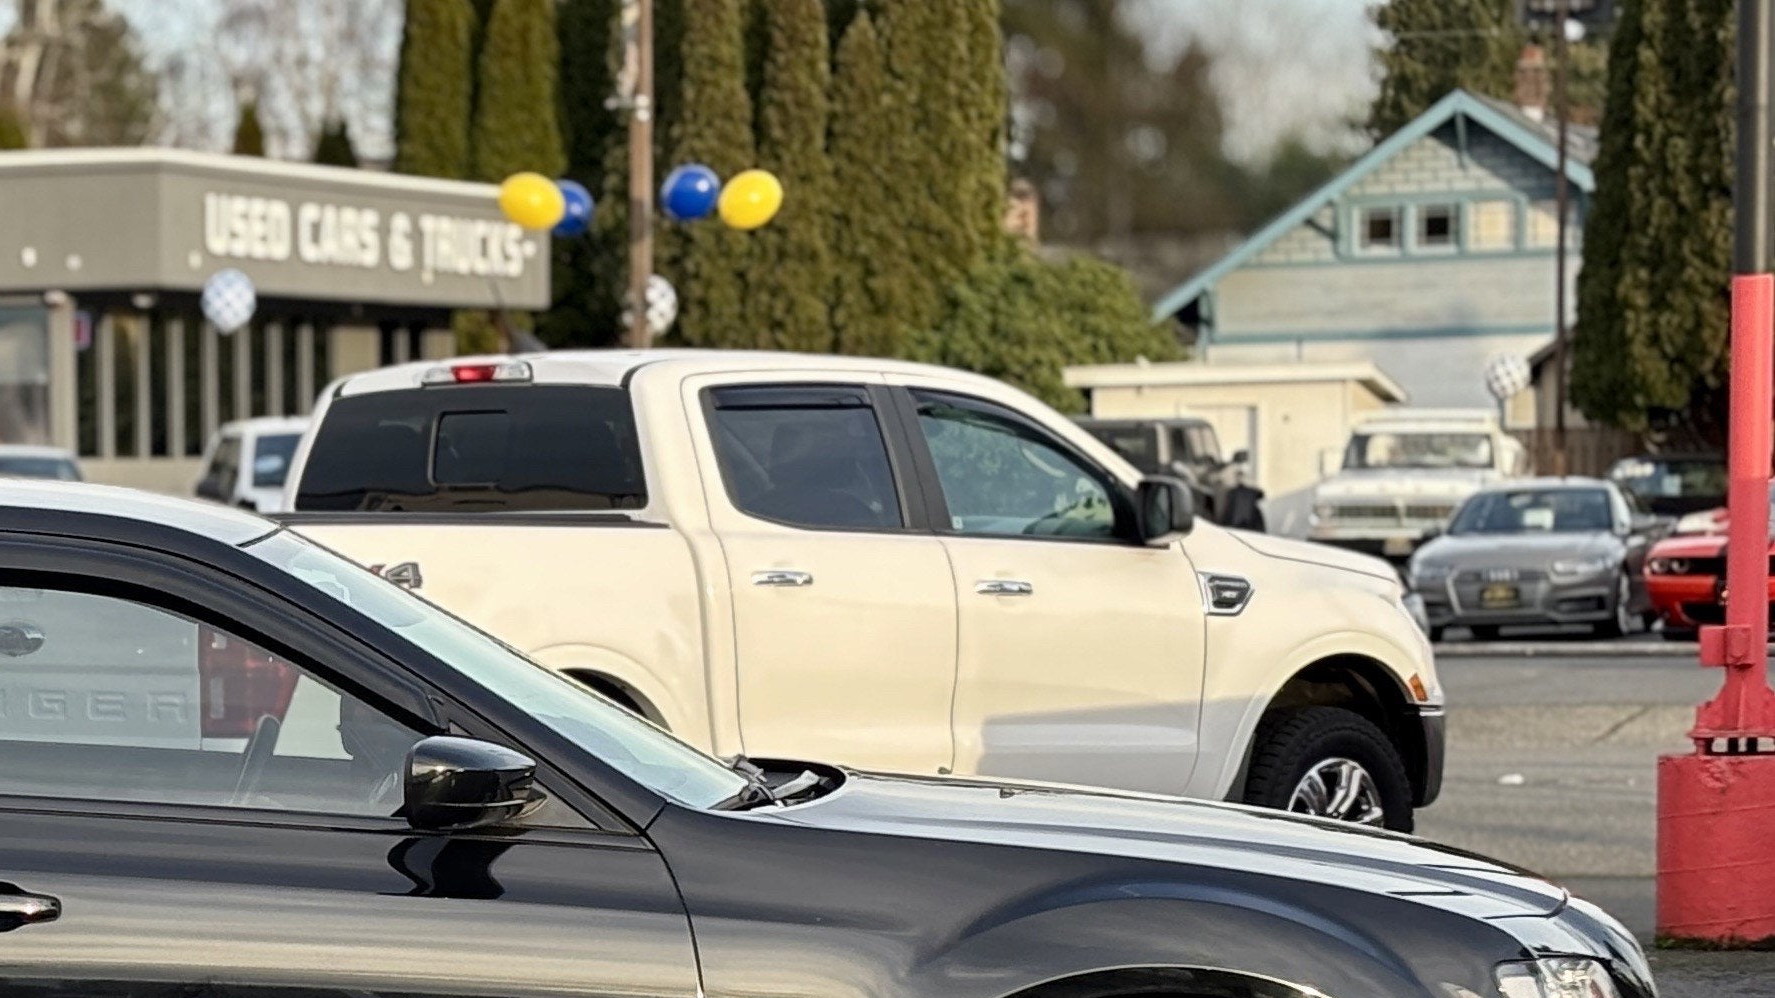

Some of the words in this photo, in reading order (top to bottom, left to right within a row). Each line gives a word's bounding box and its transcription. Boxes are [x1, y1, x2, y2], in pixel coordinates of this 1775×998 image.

[204, 192, 291, 261] USED
[297, 202, 380, 268] CARS
[388, 211, 414, 272] &
[419, 213, 525, 279] TRUCKS
